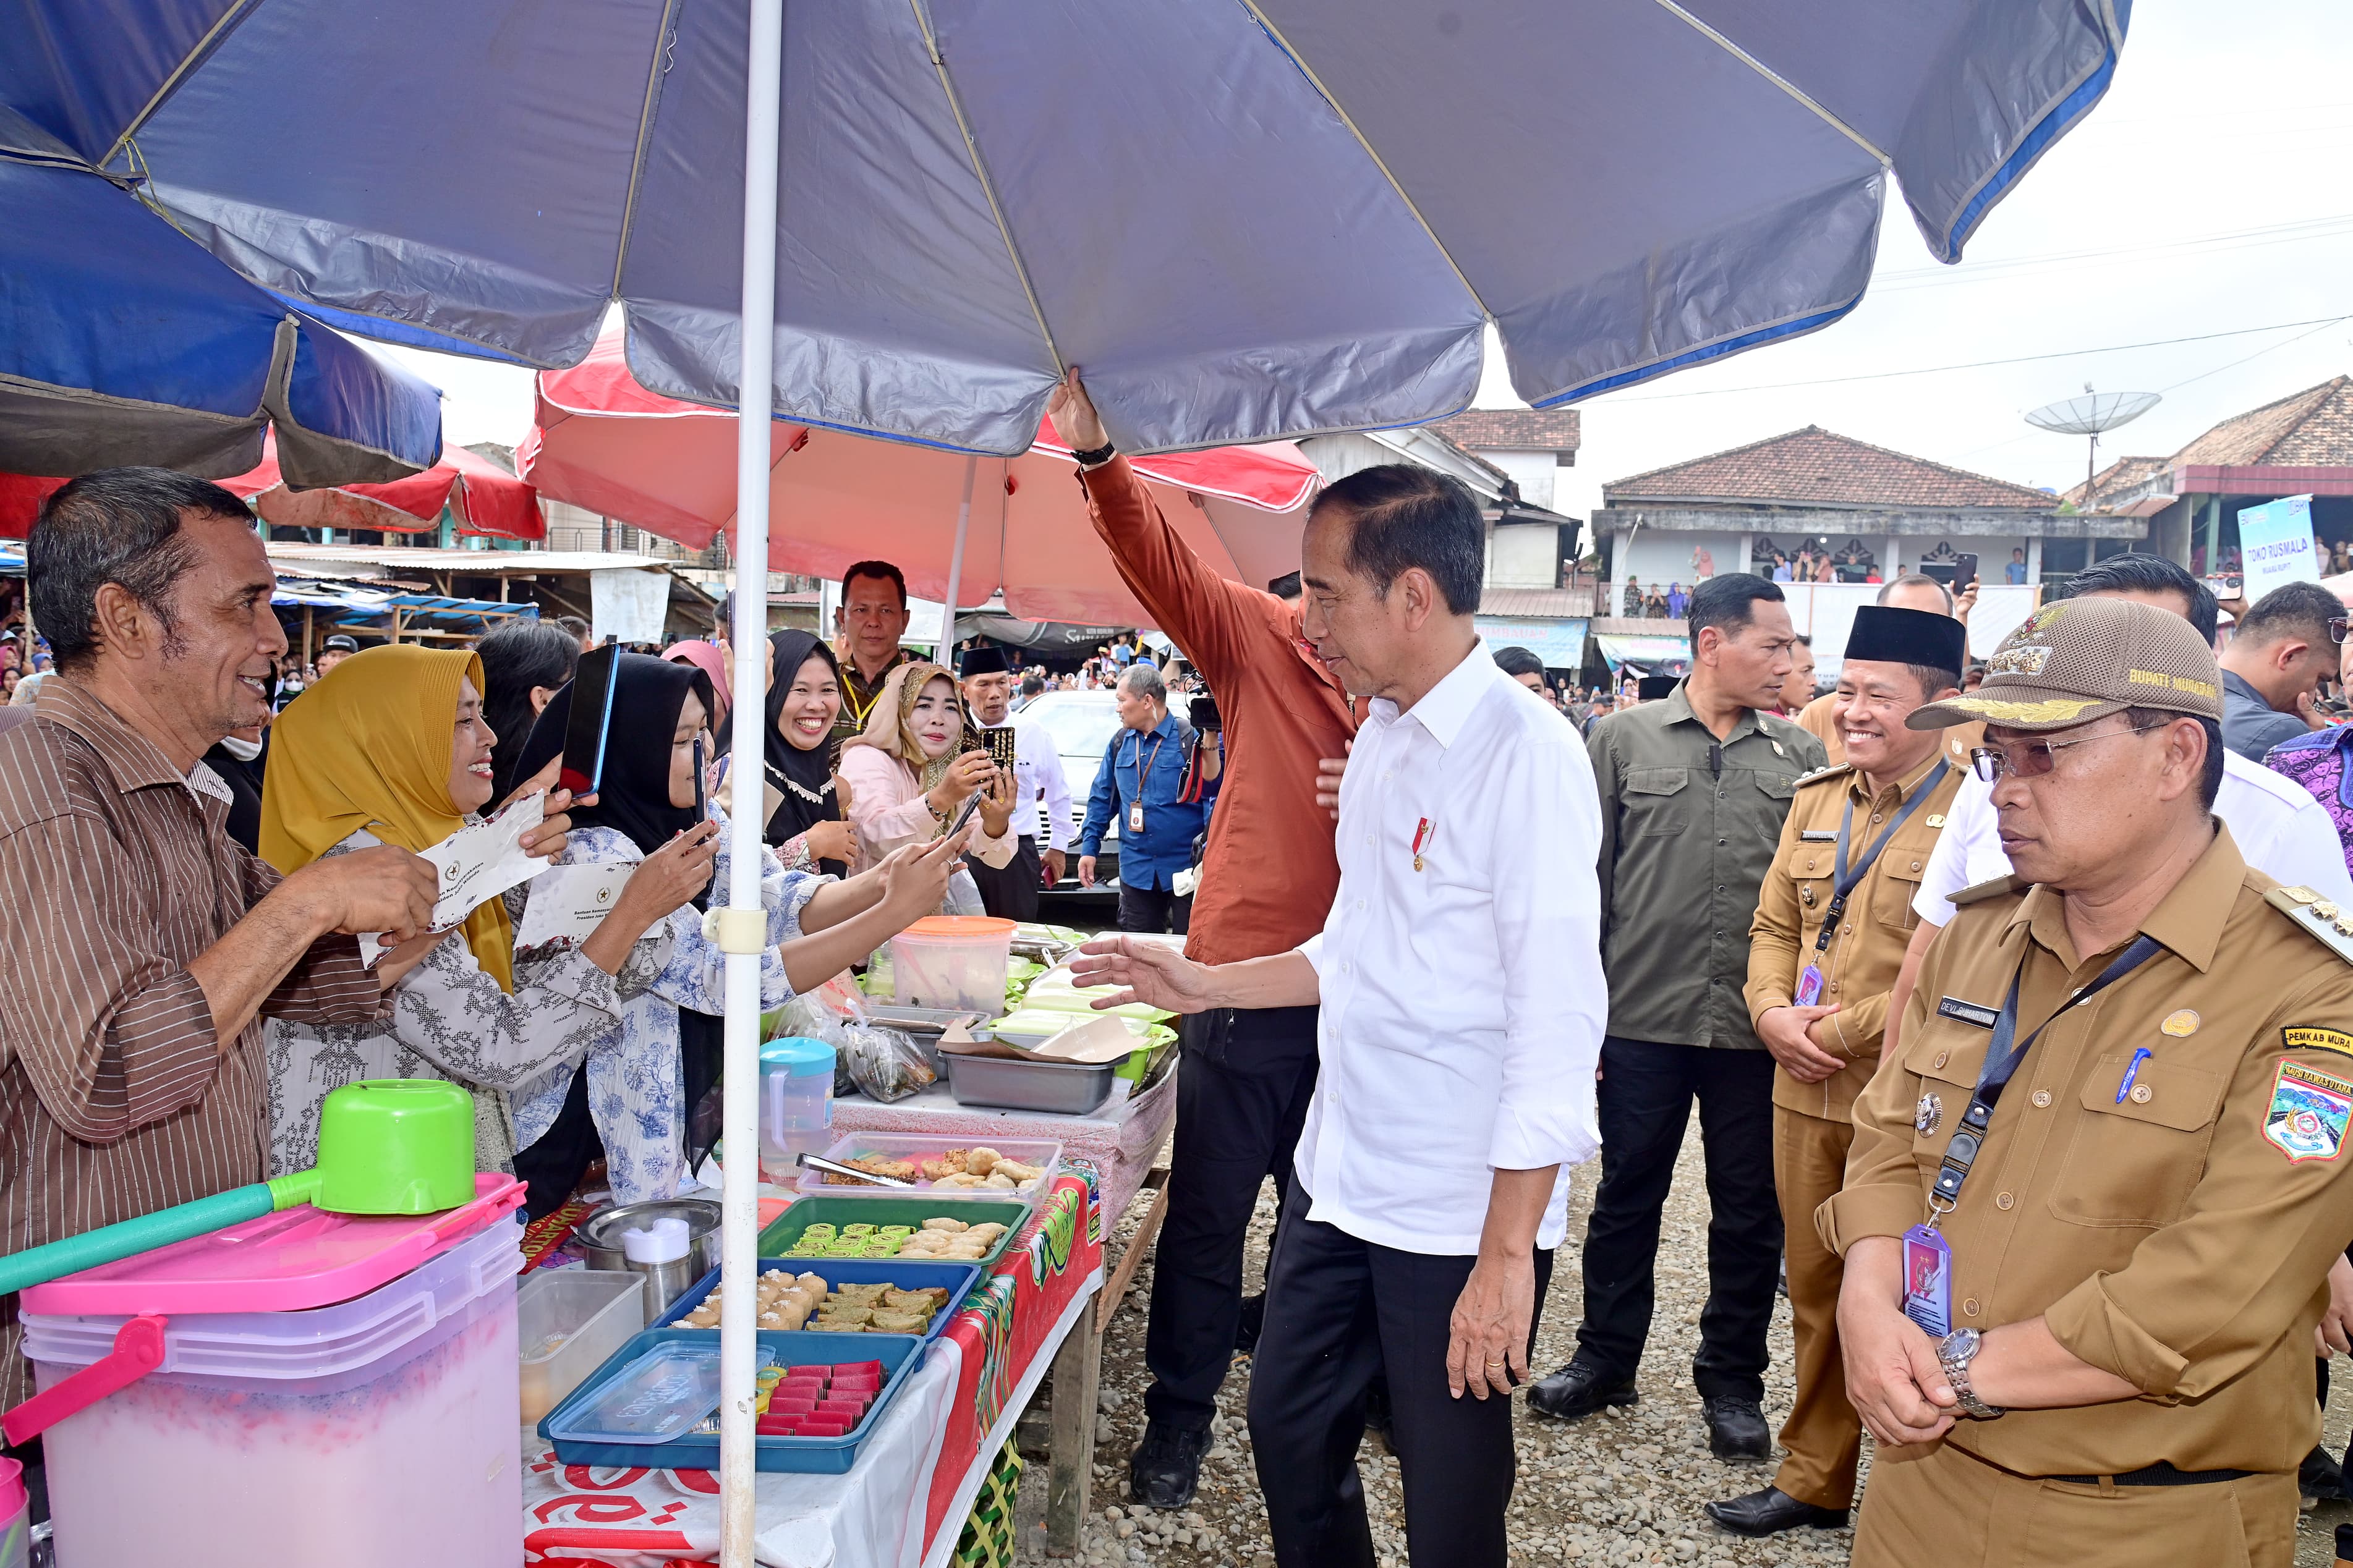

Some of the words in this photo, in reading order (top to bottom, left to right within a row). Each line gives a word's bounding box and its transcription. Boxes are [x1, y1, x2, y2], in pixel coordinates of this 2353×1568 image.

[2248, 546, 2266, 562] TOKO
[2268, 537, 2308, 559] RUSMALA
[2130, 669, 2169, 688] BUPATI
[1941, 1002, 1957, 1012] DEVI
[2289, 1032, 2325, 1042] PEMKAB
[2286, 1065, 2304, 1077] MUSI
[2304, 1074, 2329, 1087] RAWAS
[2329, 1081, 2351, 1095] UTARA
